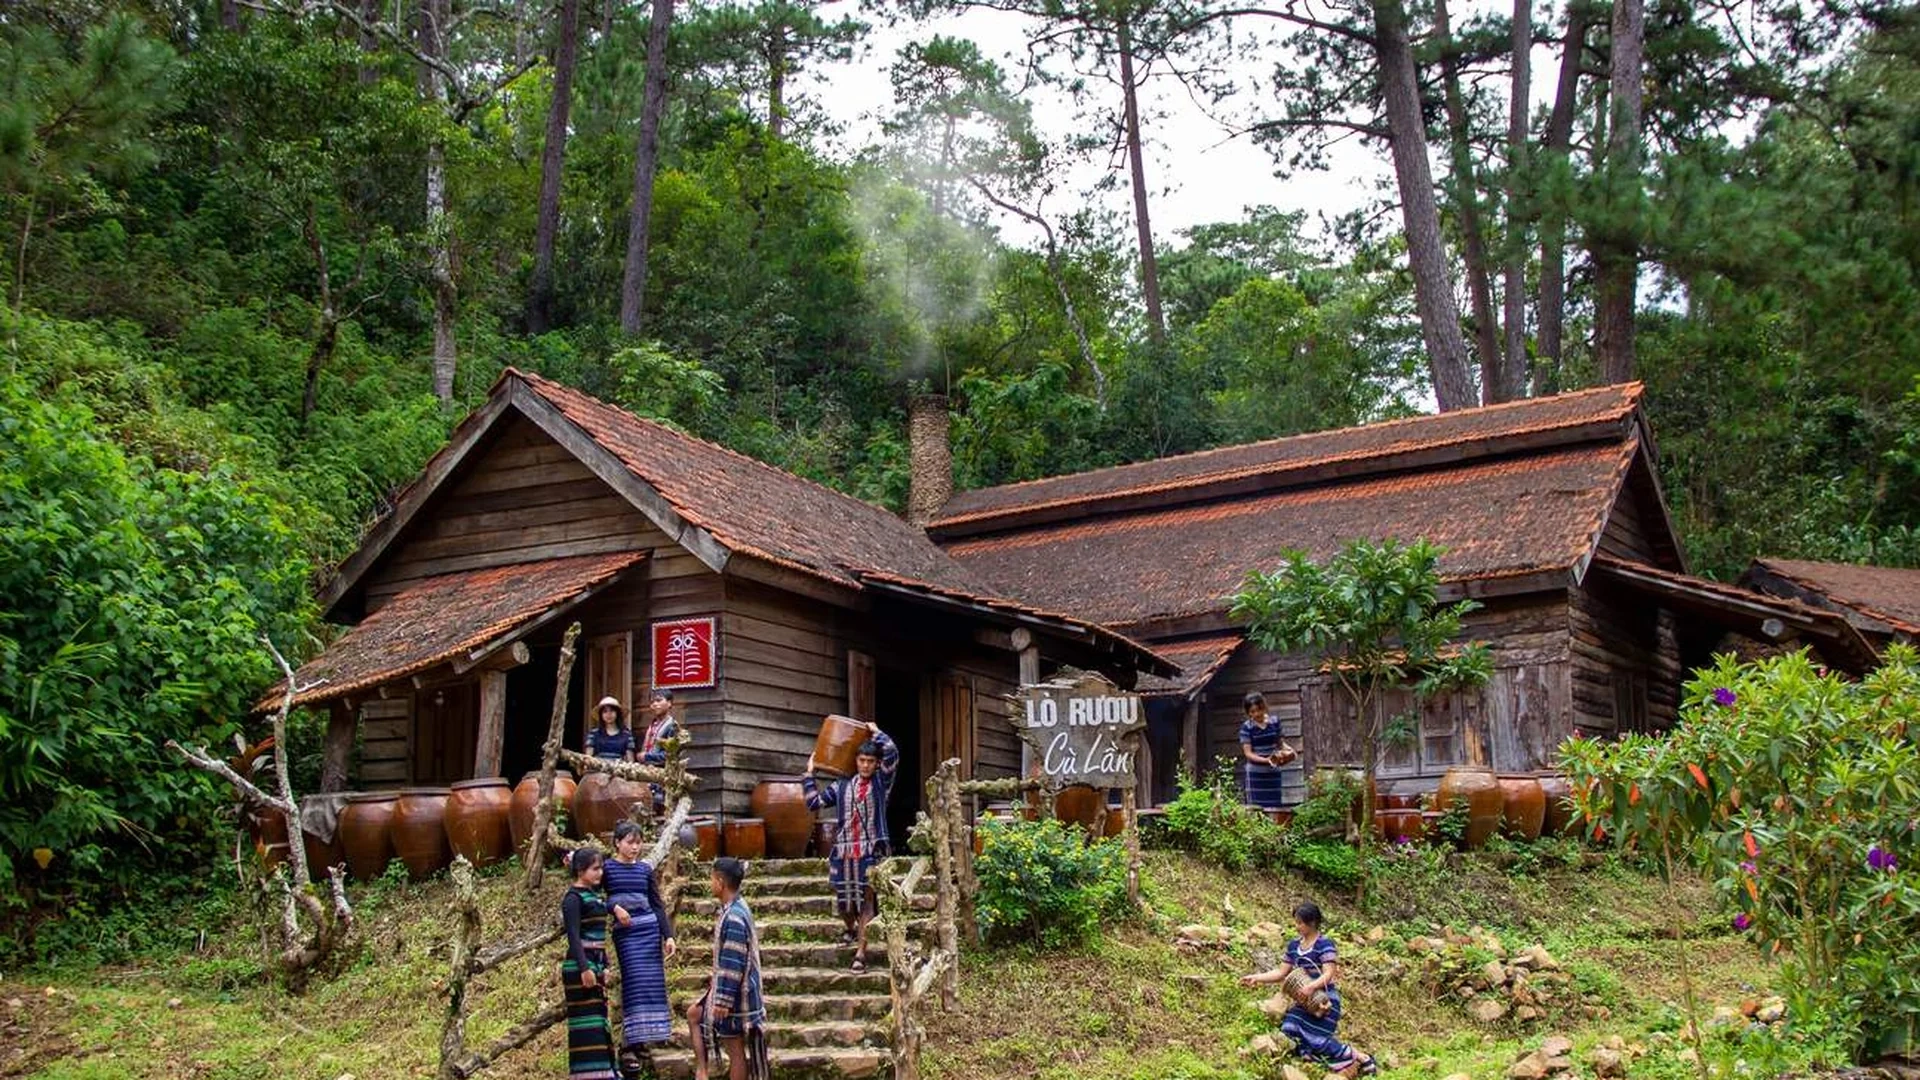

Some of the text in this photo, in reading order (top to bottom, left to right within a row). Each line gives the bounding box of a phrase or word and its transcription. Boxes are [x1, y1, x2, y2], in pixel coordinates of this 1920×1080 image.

[1026, 692, 1138, 731] LÒ RƯỢU
[1044, 732, 1129, 775] Cù Lần
